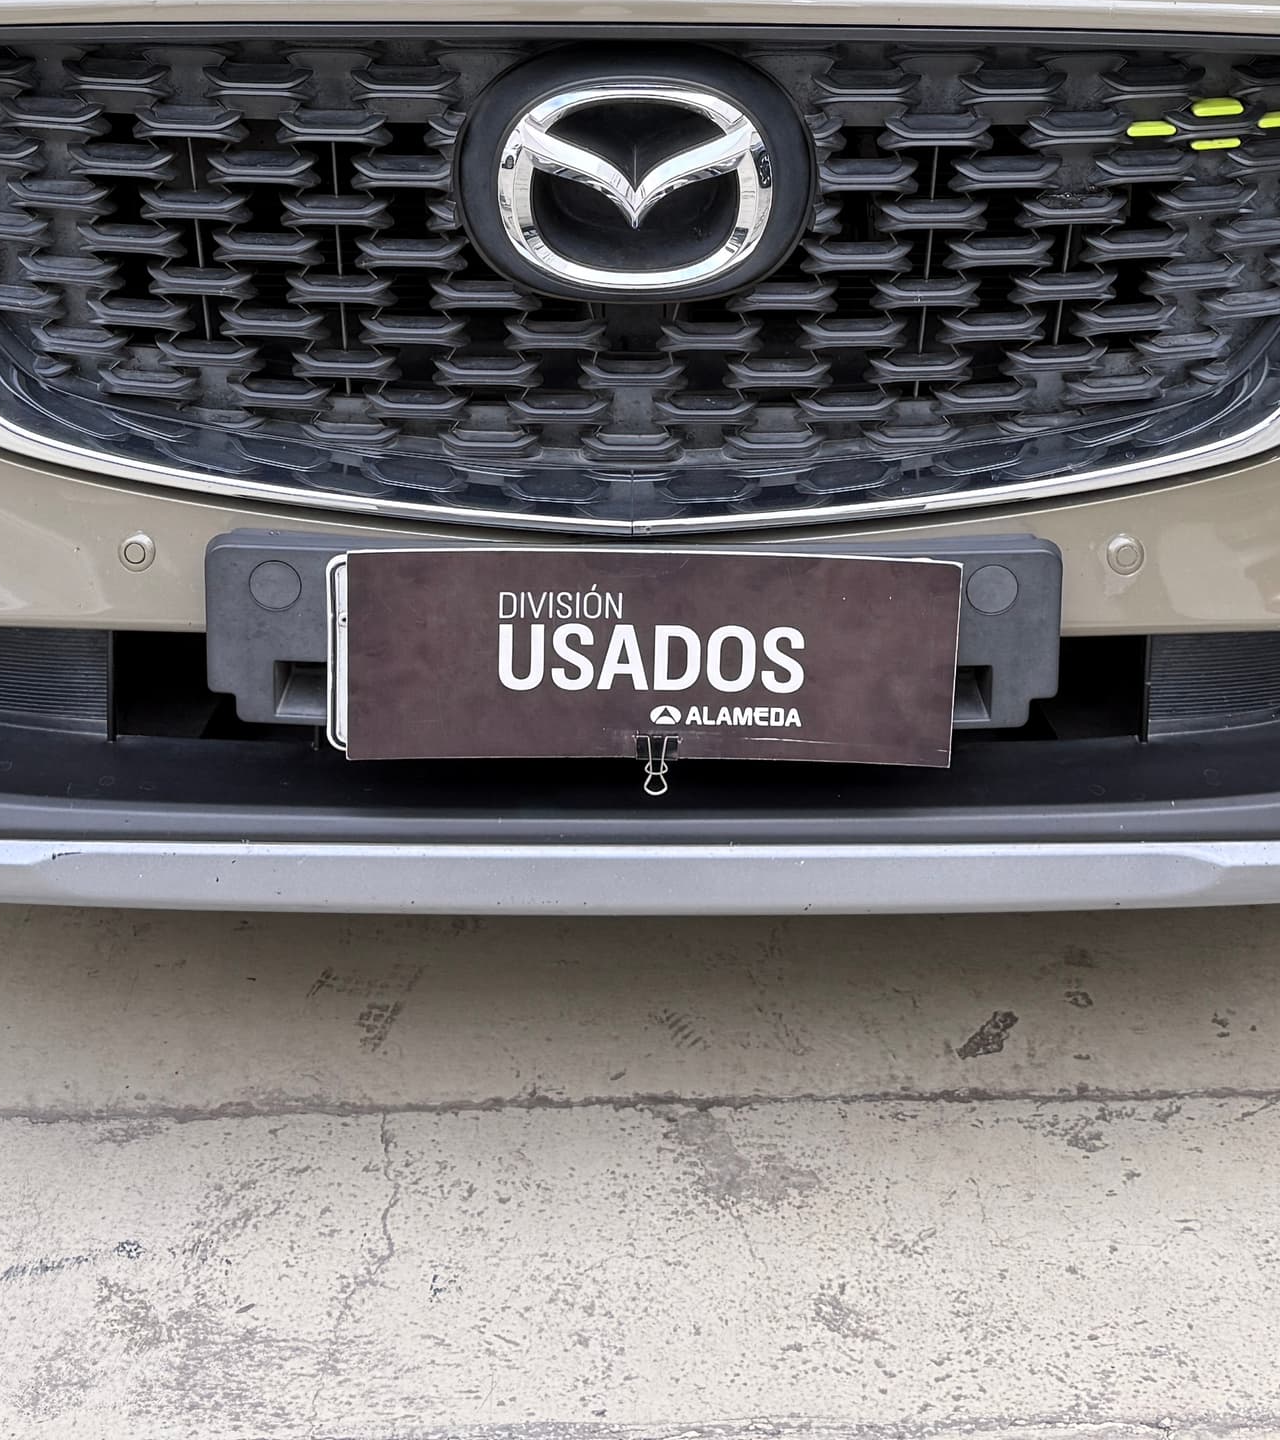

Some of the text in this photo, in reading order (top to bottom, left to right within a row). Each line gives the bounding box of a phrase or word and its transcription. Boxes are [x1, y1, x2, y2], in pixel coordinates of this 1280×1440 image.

[498, 583, 623, 619] DIVISIÓN
[498, 622, 805, 694] USADOS
[685, 705, 802, 728] ALAMEDA
